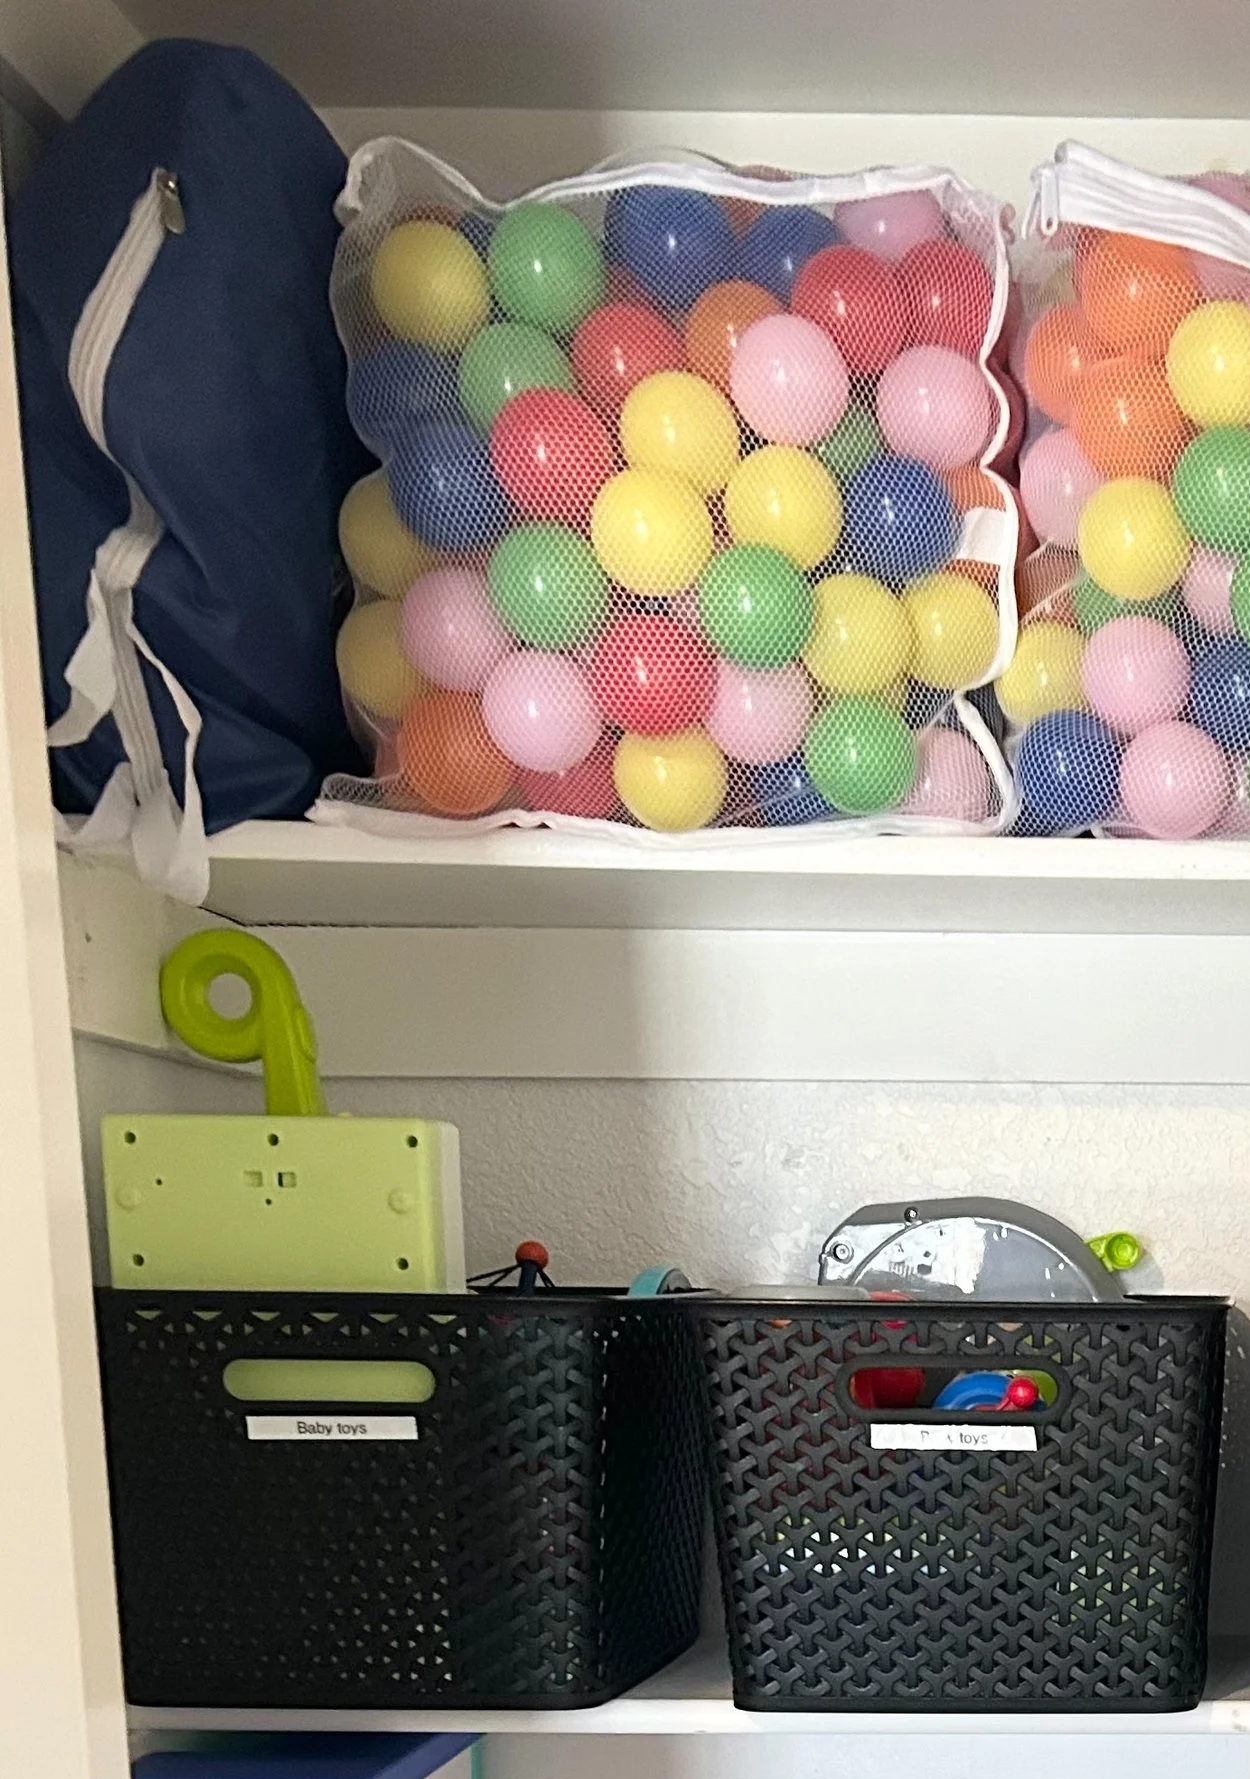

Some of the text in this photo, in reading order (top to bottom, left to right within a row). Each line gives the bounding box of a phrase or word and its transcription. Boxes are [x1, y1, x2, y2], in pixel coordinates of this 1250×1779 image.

[297, 1421, 367, 1435] Baby toys
[959, 1432, 988, 1446] toys
